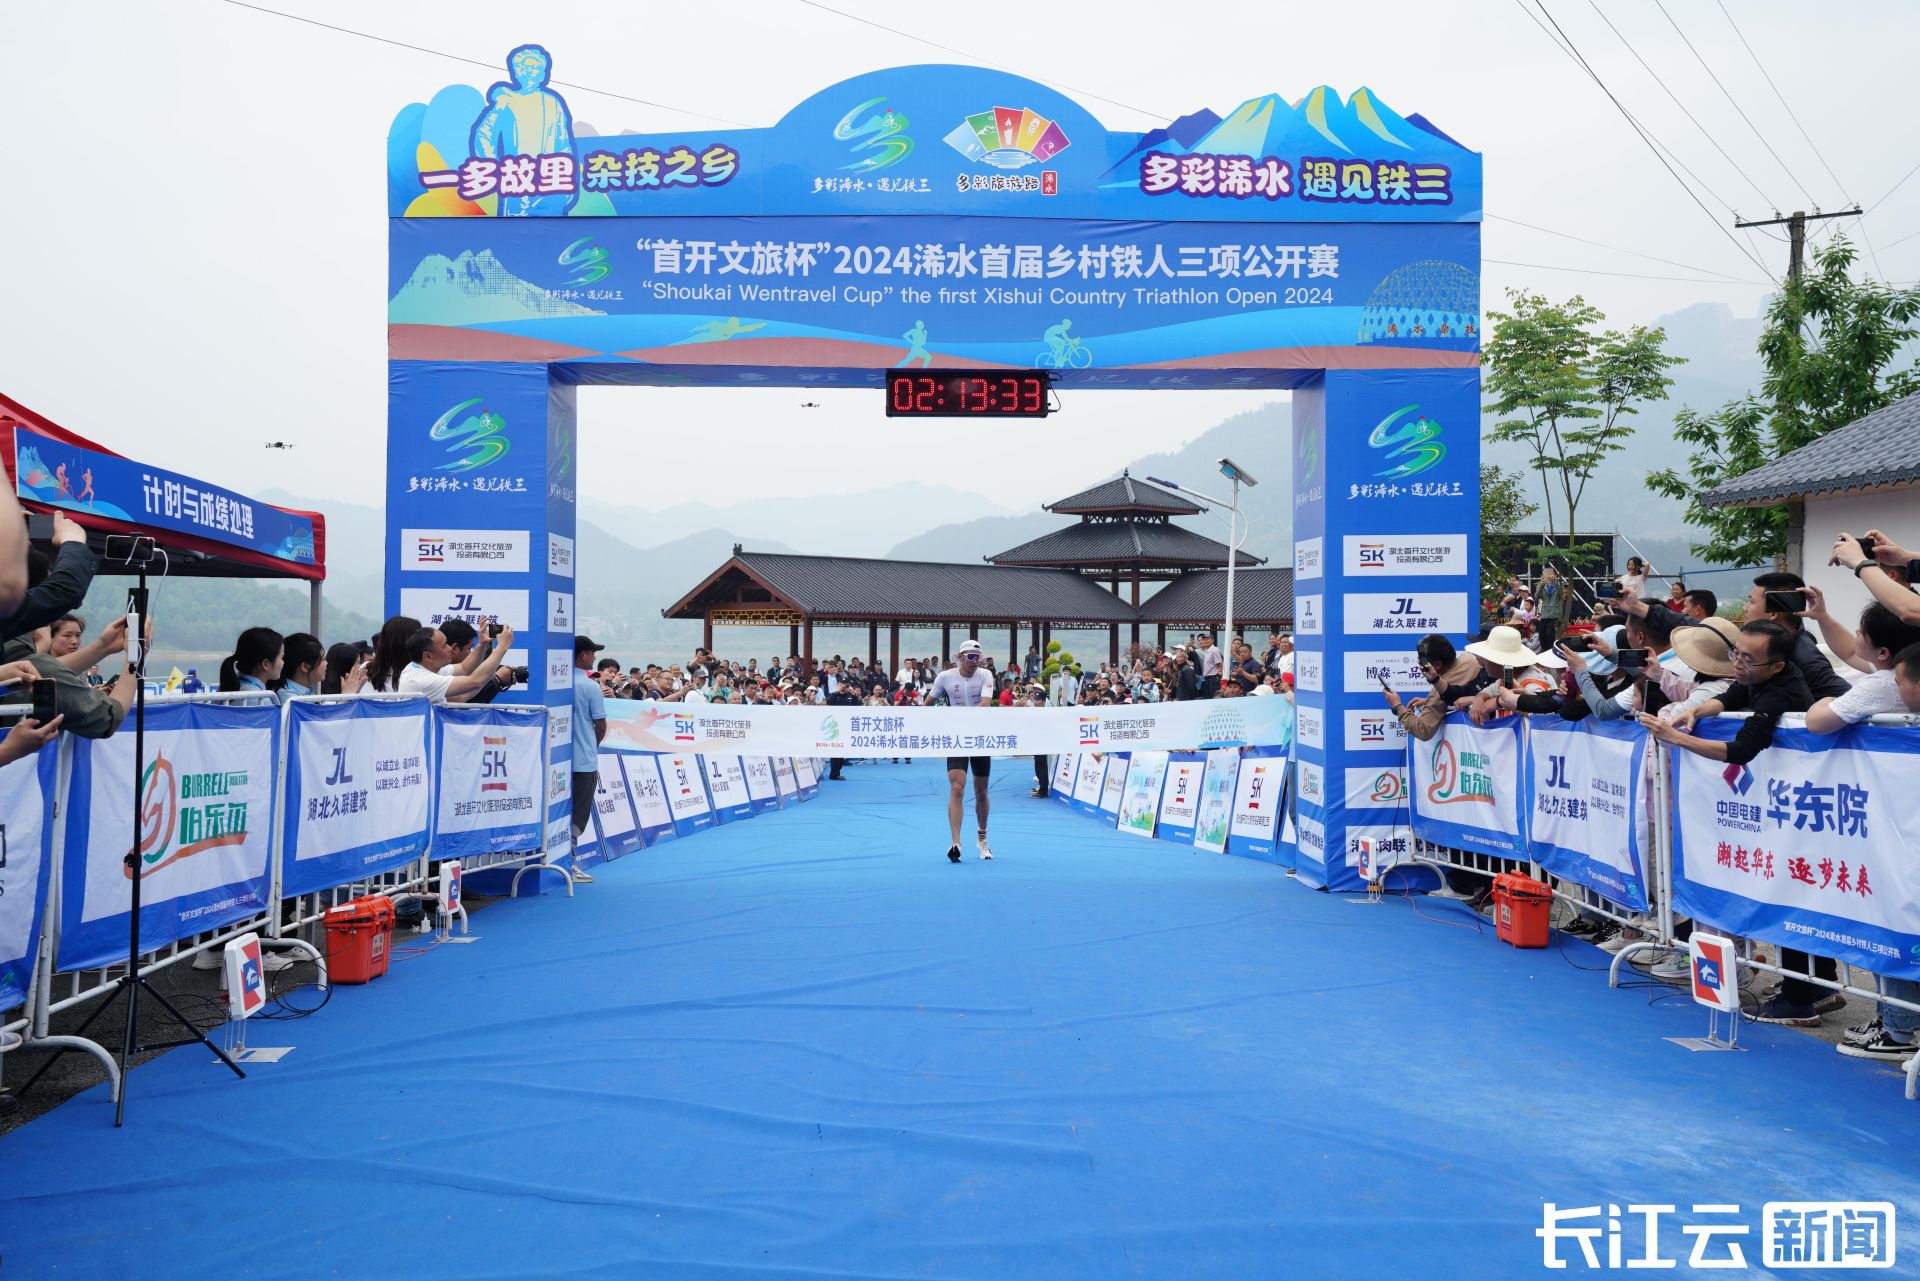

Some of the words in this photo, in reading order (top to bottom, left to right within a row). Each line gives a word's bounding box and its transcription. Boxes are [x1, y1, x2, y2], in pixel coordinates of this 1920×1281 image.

[421, 156, 576, 199] 一多故里
[586, 147, 737, 188] 杂技之乡
[1145, 156, 1291, 199] 多彩浠水
[1303, 162, 1449, 201] 遇见铁三
[636, 238, 1340, 279] “首开文旅杯”2024浠水首届乡村铁人三项公开赛
[642, 280, 732, 301] “Shoukai
[739, 284, 837, 303] Wentravel
[843, 286, 893, 306] Cup”
[901, 287, 931, 304] the
[938, 287, 977, 304] first
[984, 287, 1043, 305] Xishui
[1050, 287, 1127, 308] Country
[1134, 288, 1219, 305] Triathlon
[1226, 288, 1277, 308] Open
[1284, 288, 1333, 305] 2024
[893, 378, 1041, 413] 02:13:33
[143, 474, 254, 540] 计时与成绩处理
[418, 544, 444, 556] SK
[1360, 549, 1384, 562] SK
[448, 594, 482, 611] JL
[1389, 598, 1422, 615] JL
[1373, 618, 1439, 628] 湖北久联建筑
[675, 720, 695, 734] SK
[850, 716, 905, 732] 首开文旅杯
[1079, 724, 1099, 738] SK
[1361, 724, 1385, 736] SK
[850, 735, 1018, 749] 2024浠水首届乡村铁人三项公开赛
[325, 748, 353, 785] JL
[481, 751, 507, 778] SK
[1545, 755, 1571, 789] JL
[307, 789, 368, 821] 湖北久联建筑
[1717, 800, 1761, 822] 中国电建
[1766, 777, 1869, 838] 华东院
[1717, 817, 1761, 833] POWERCHINA
[1717, 841, 1775, 881] 潮起华东
[1787, 858, 1873, 898] 逐梦未来
